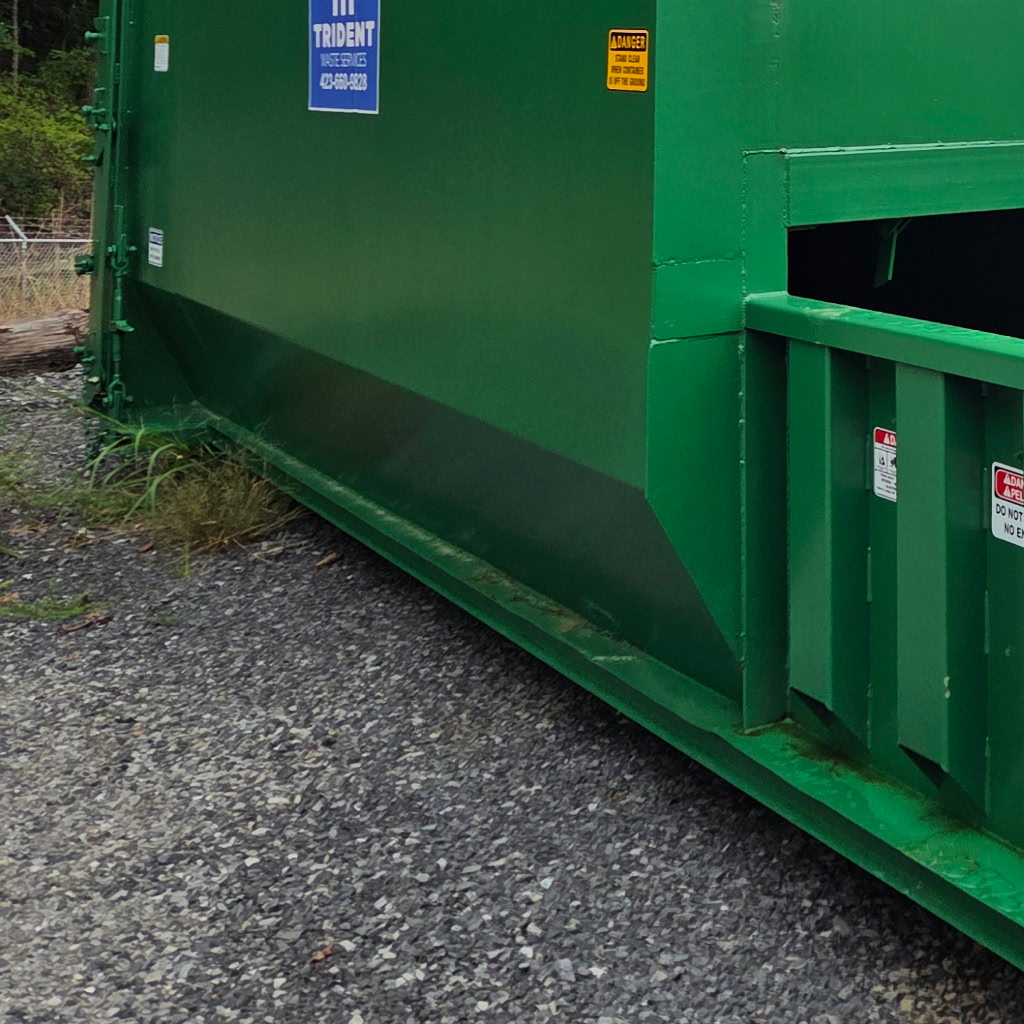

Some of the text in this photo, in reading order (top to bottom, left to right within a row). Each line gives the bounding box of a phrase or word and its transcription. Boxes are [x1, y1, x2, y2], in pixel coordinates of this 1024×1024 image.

[313, 20, 375, 48] TRIDENT
[617, 35, 646, 49] DANGER
[995, 504, 1023, 522] DO NOT
[1004, 522, 1014, 535] NO
